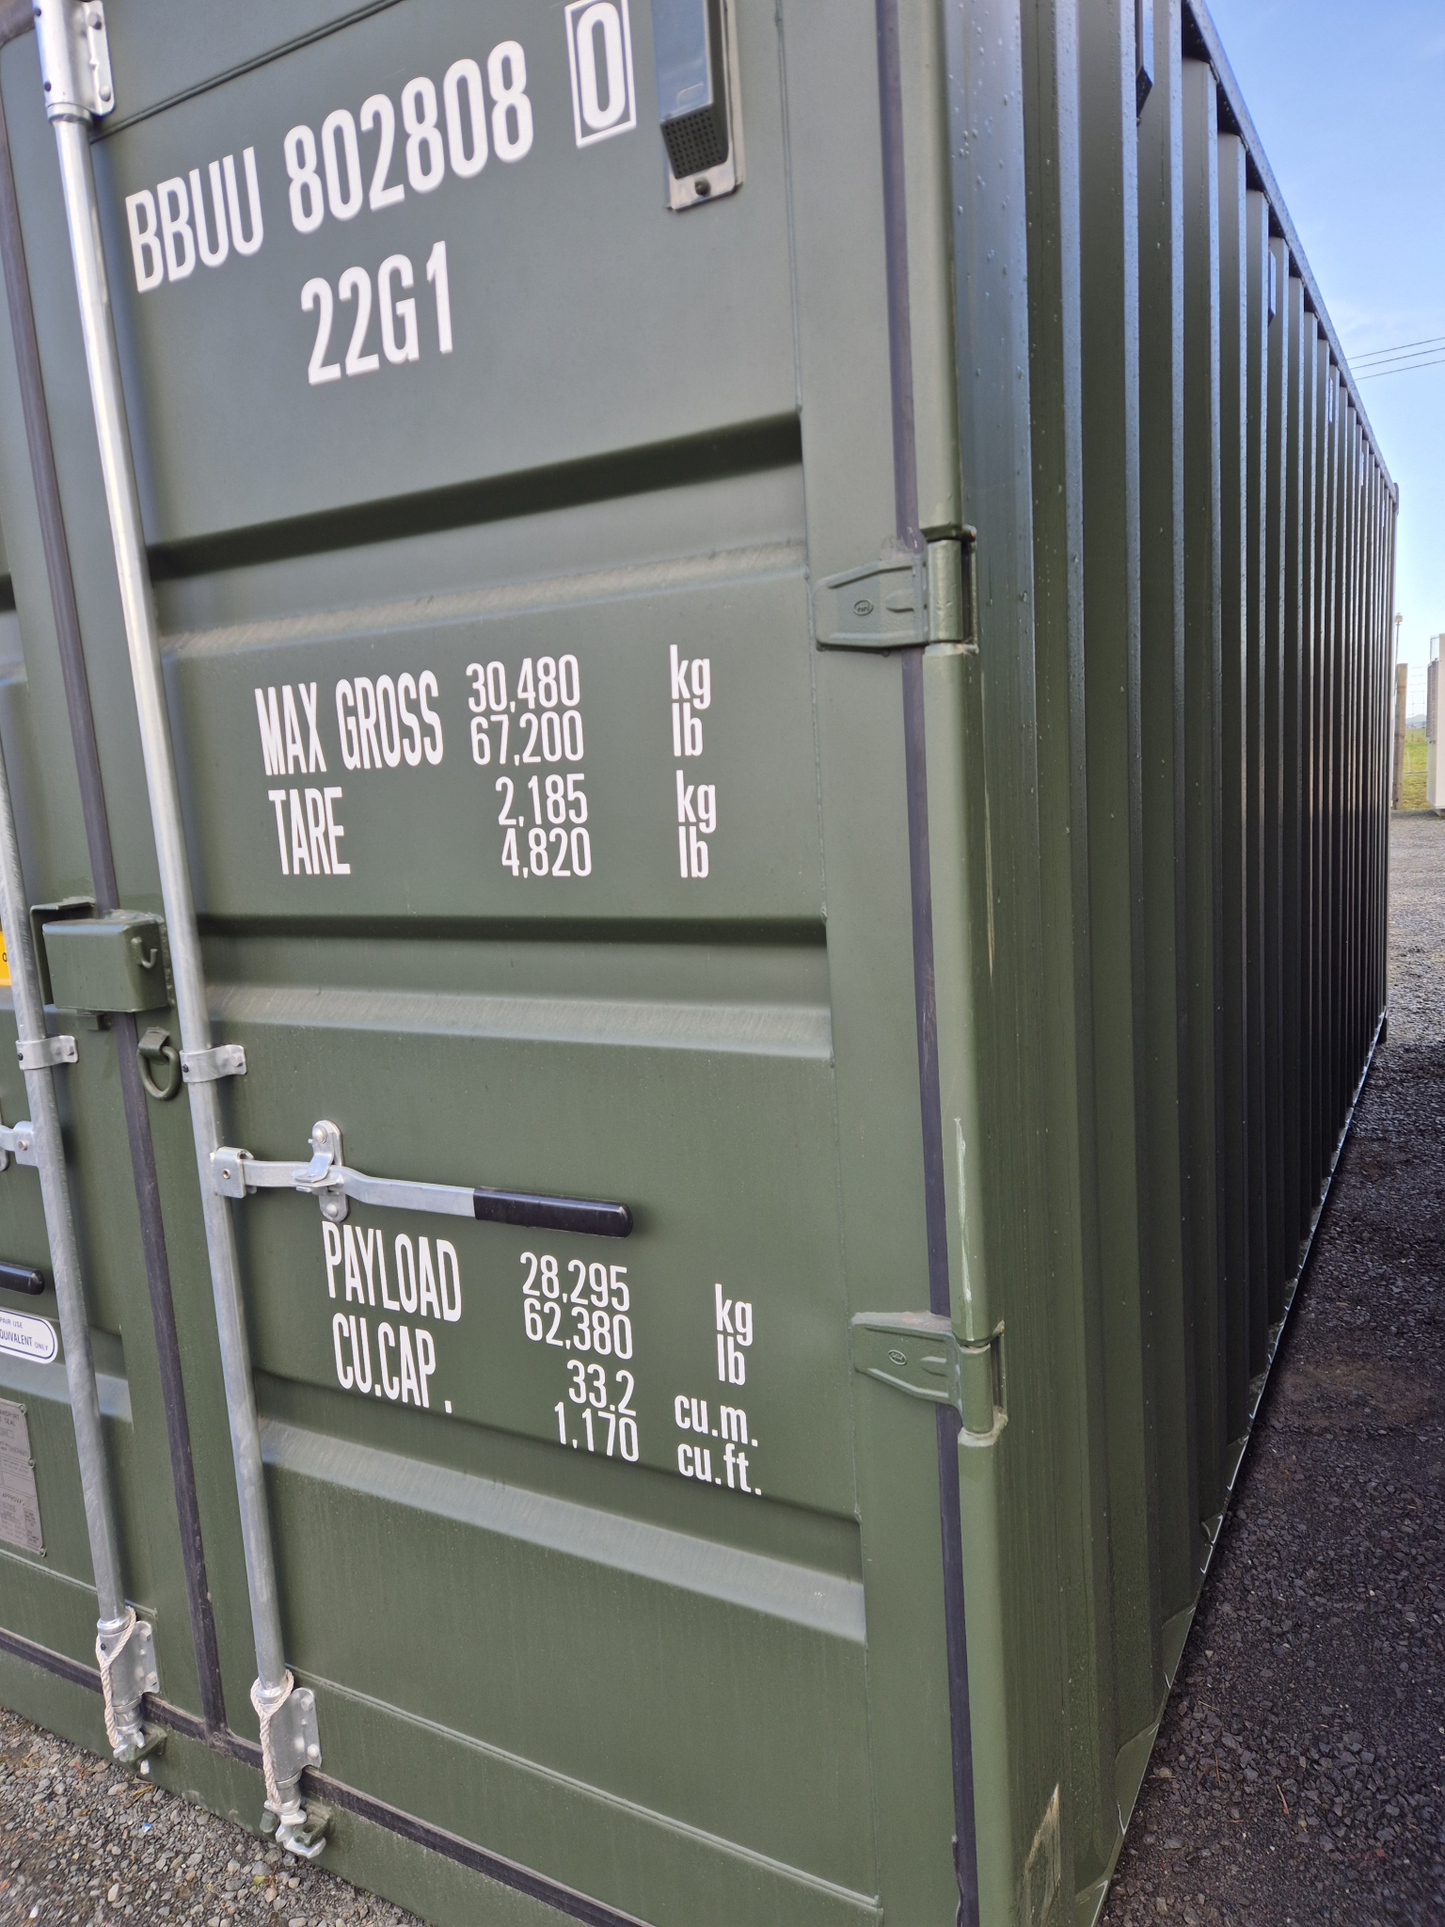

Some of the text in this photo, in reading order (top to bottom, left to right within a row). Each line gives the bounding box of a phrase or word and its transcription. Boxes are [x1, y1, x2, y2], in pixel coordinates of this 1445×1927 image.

[125, 146, 264, 293] BBUU
[283, 40, 534, 234] 802808
[300, 240, 454, 386] 22G1
[254, 681, 327, 776] MAX
[335, 669, 444, 771] GROSS
[669, 643, 712, 710] kg
[671, 701, 704, 758] lb
[267, 786, 351, 876] TARE
[675, 769, 717, 834] kg
[678, 825, 709, 879] lb
[321, 1220, 462, 1322] PAYLOAD
[714, 1283, 754, 1347] kg
[34, 1341, 49, 1351] ONLY
[716, 1333, 746, 1386] lb
[566, 1359, 637, 1417] 33.2
[674, 1395, 758, 1448] cu.m.
[677, 1443, 762, 1496] cu.ft.
